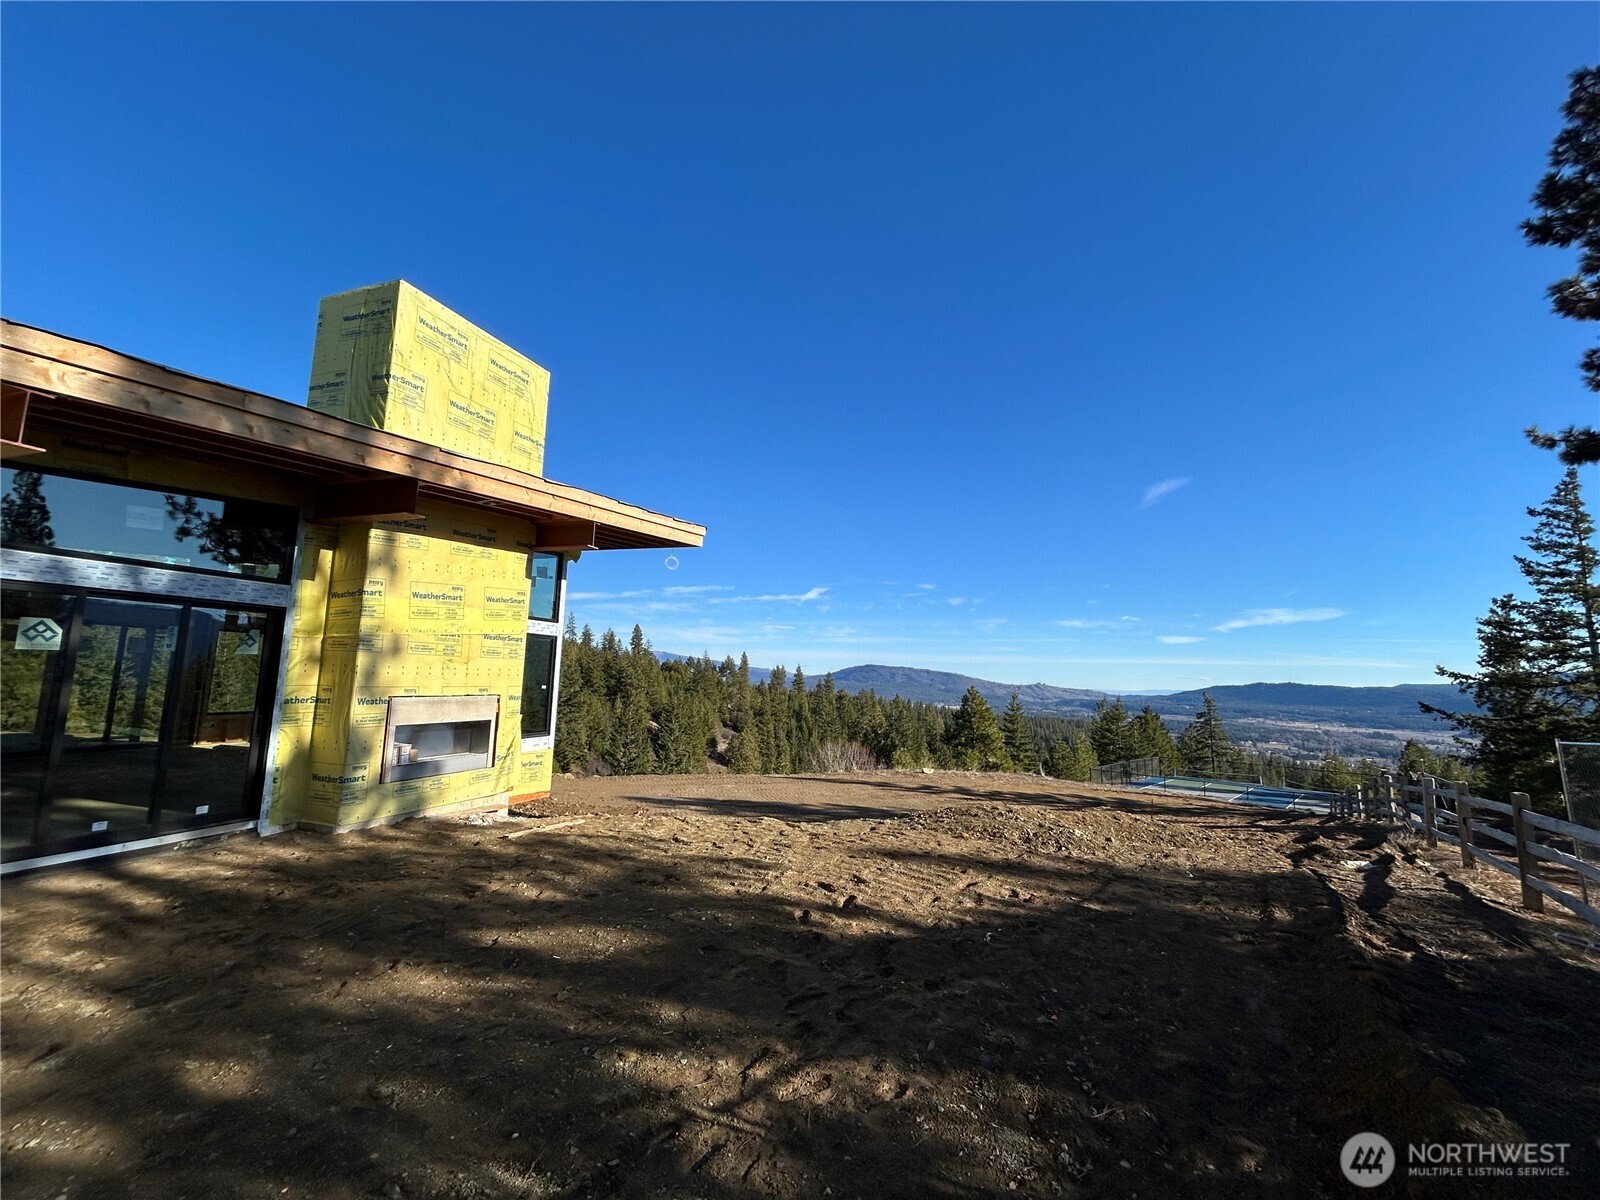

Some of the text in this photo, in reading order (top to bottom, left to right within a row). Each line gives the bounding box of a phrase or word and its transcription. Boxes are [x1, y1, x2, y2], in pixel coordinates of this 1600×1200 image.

[418, 316, 468, 350] WeatherSmart
[490, 358, 529, 385] WeatherSmart
[449, 399, 495, 425] WeatherSmart
[514, 430, 544, 447] WeatherSm
[331, 588, 383, 599] WeatherSmart
[412, 591, 463, 601] WeatherSmart
[486, 596, 525, 605] WeatherSmart
[483, 634, 523, 642] WeatherSmart
[357, 697, 388, 705] Weathe
[312, 773, 366, 784] WeatherSmart
